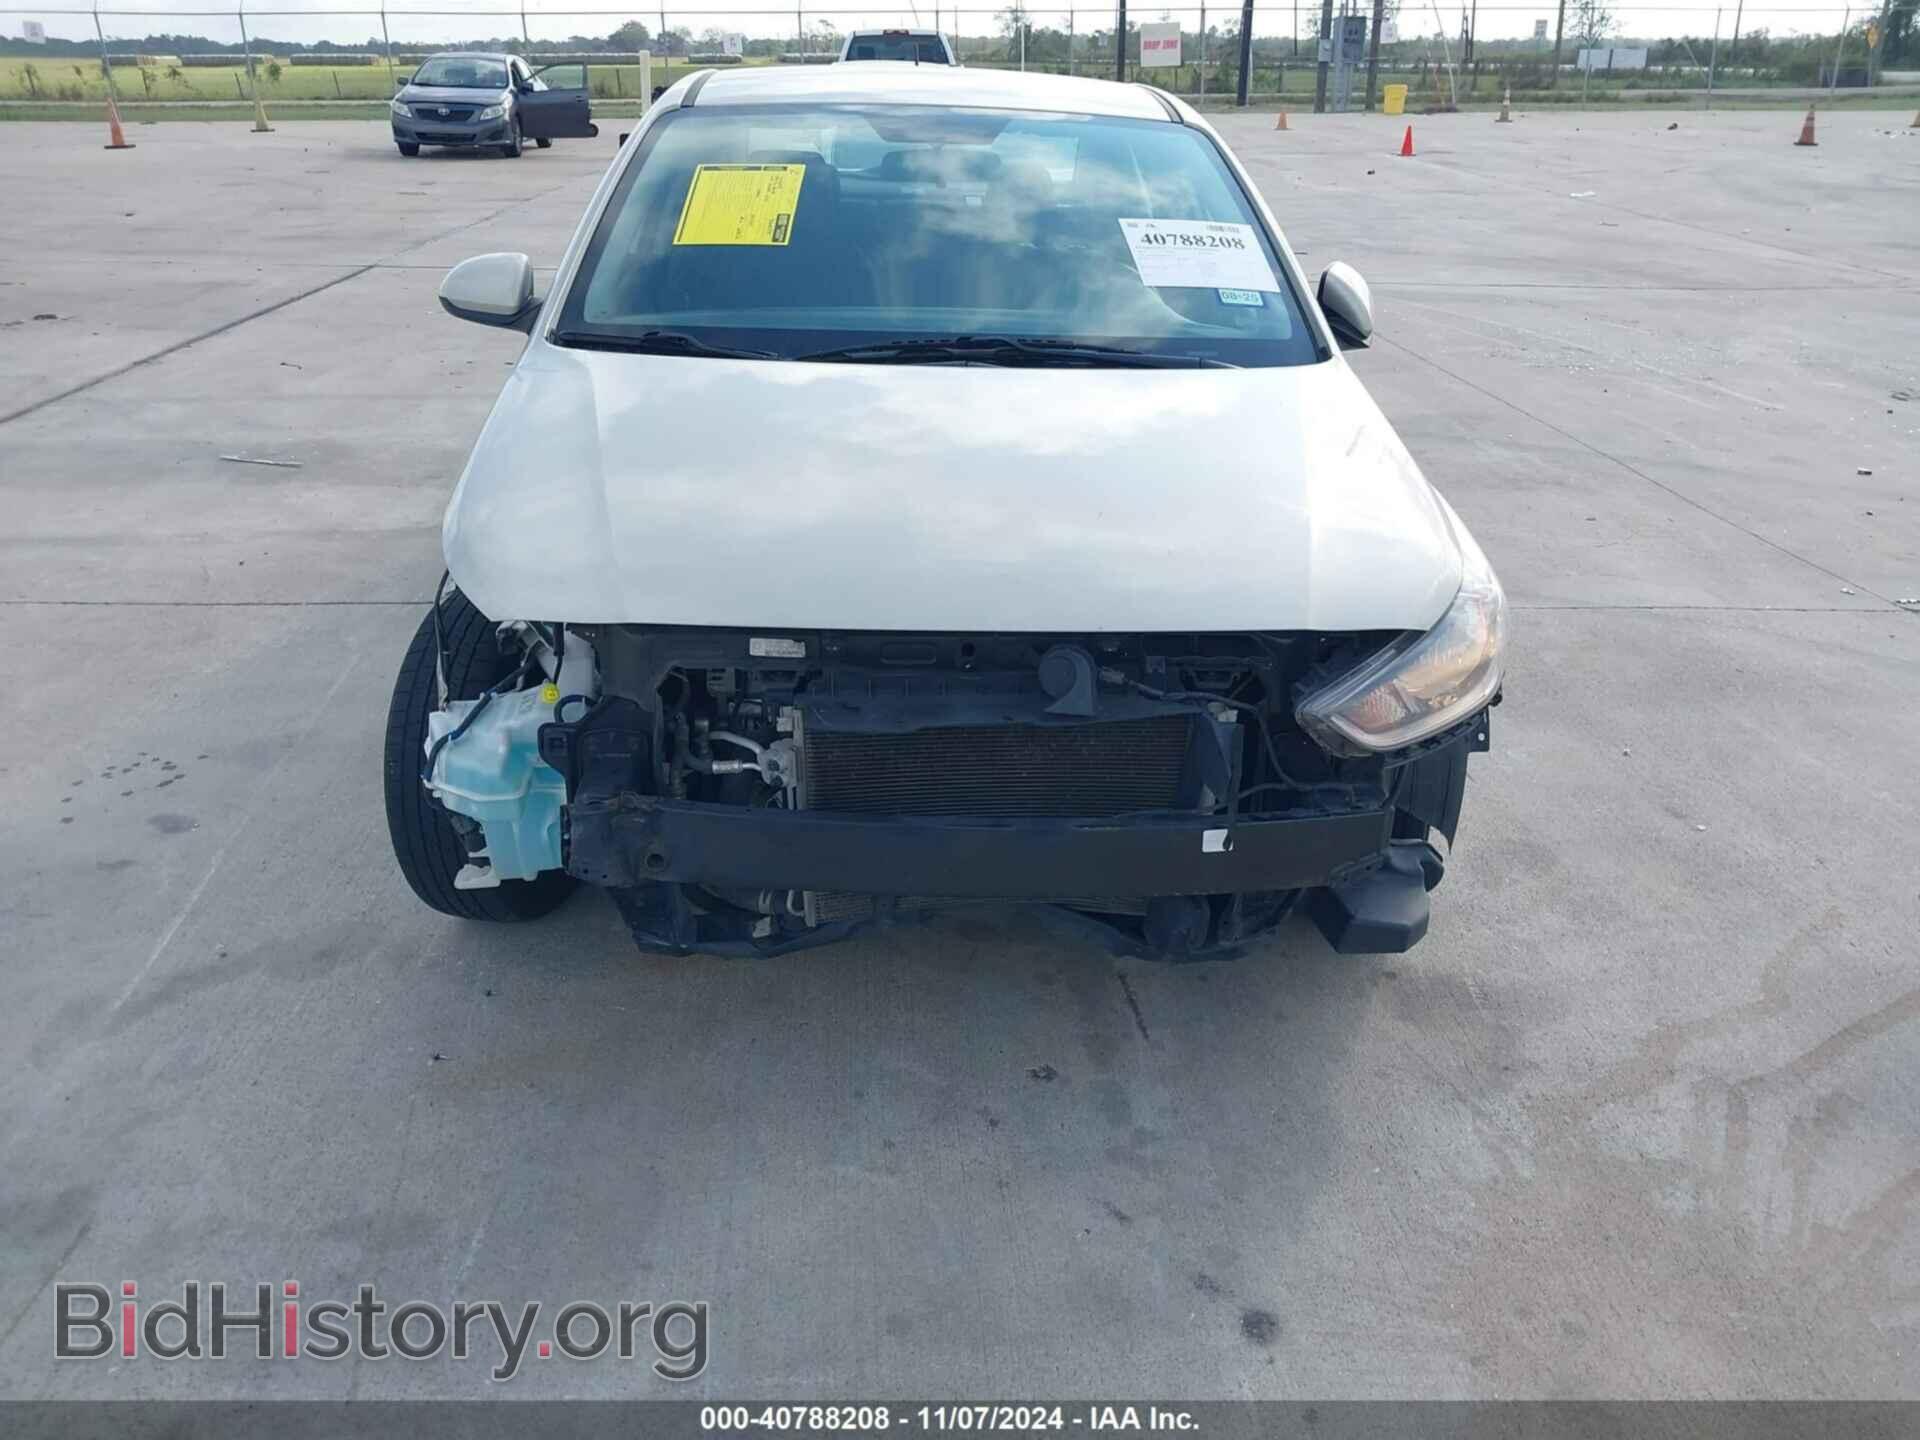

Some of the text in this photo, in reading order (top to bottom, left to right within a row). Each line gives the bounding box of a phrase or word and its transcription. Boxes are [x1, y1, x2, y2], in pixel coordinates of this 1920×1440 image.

[1143, 39, 1179, 50] DROP ZONE
[1141, 232, 1246, 250] 40788208
